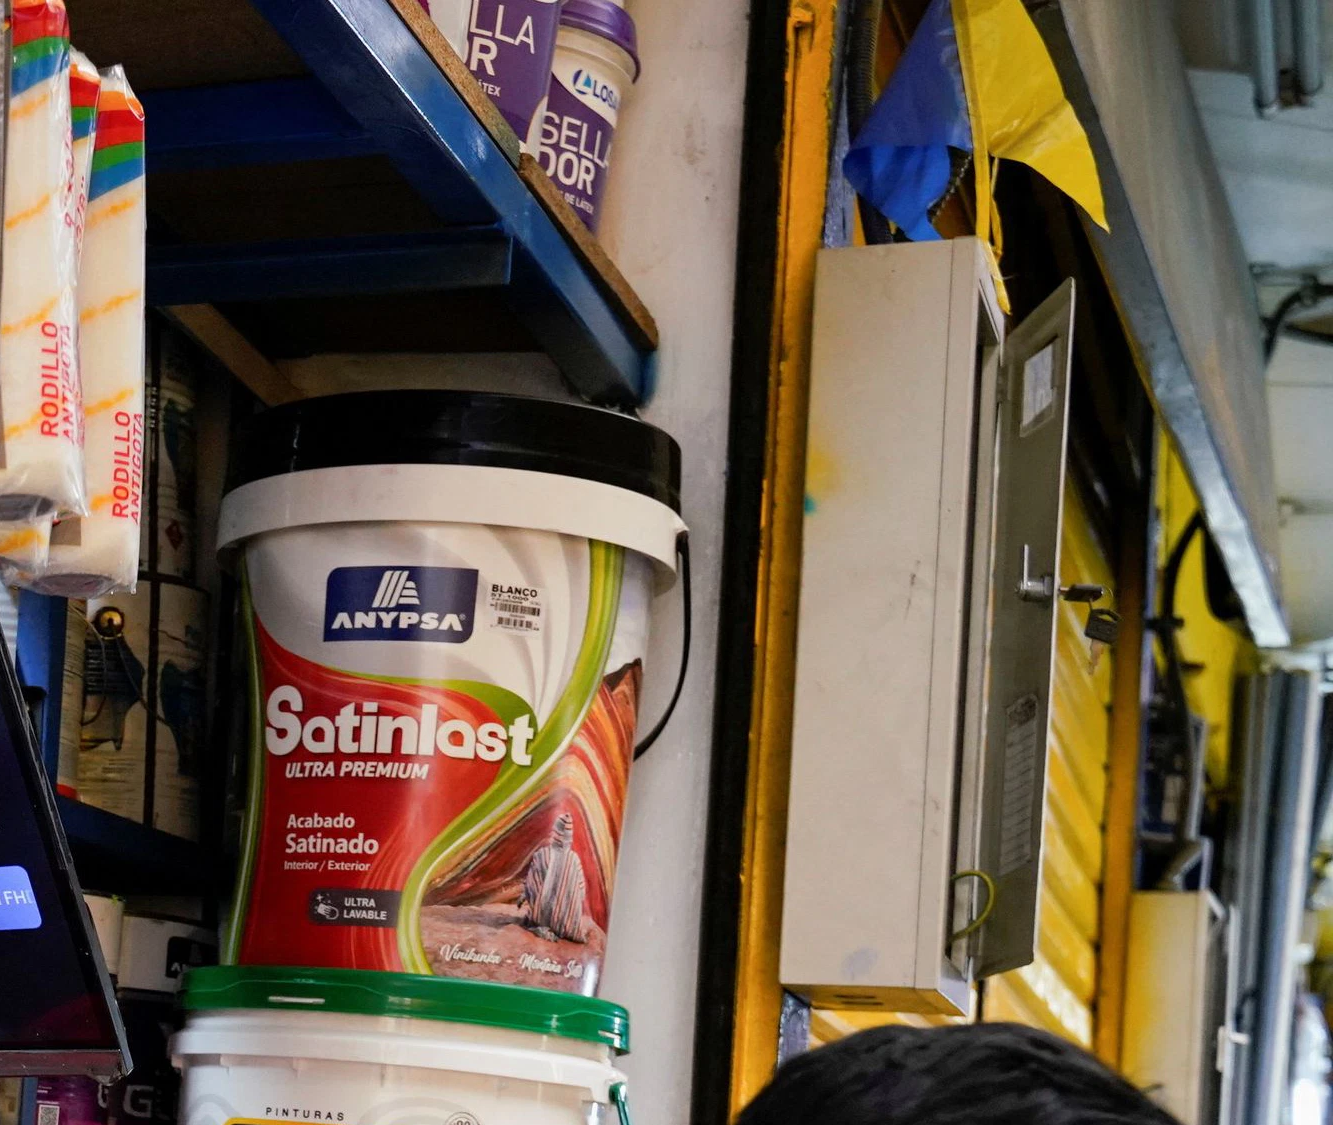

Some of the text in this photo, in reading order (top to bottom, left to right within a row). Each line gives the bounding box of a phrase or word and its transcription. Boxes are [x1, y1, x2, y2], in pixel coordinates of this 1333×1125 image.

[40, 321, 59, 438] RODILLO
[112, 410, 131, 519] RODILLO
[129, 412, 143, 526] ANTIGOTA
[491, 582, 539, 599] BLANCO
[331, 611, 462, 632] ANYPSA
[266, 685, 535, 767] Satinlast
[285, 762, 429, 780] ULTRA PREMIUM
[286, 812, 355, 830] Acabado
[284, 832, 379, 855] Satinado
[284, 859, 371, 873] Interior Exterior
[344, 897, 376, 909] ULTRA
[343, 908, 387, 922] LAVABLE
[265, 1107, 345, 1121] PINTURAS
